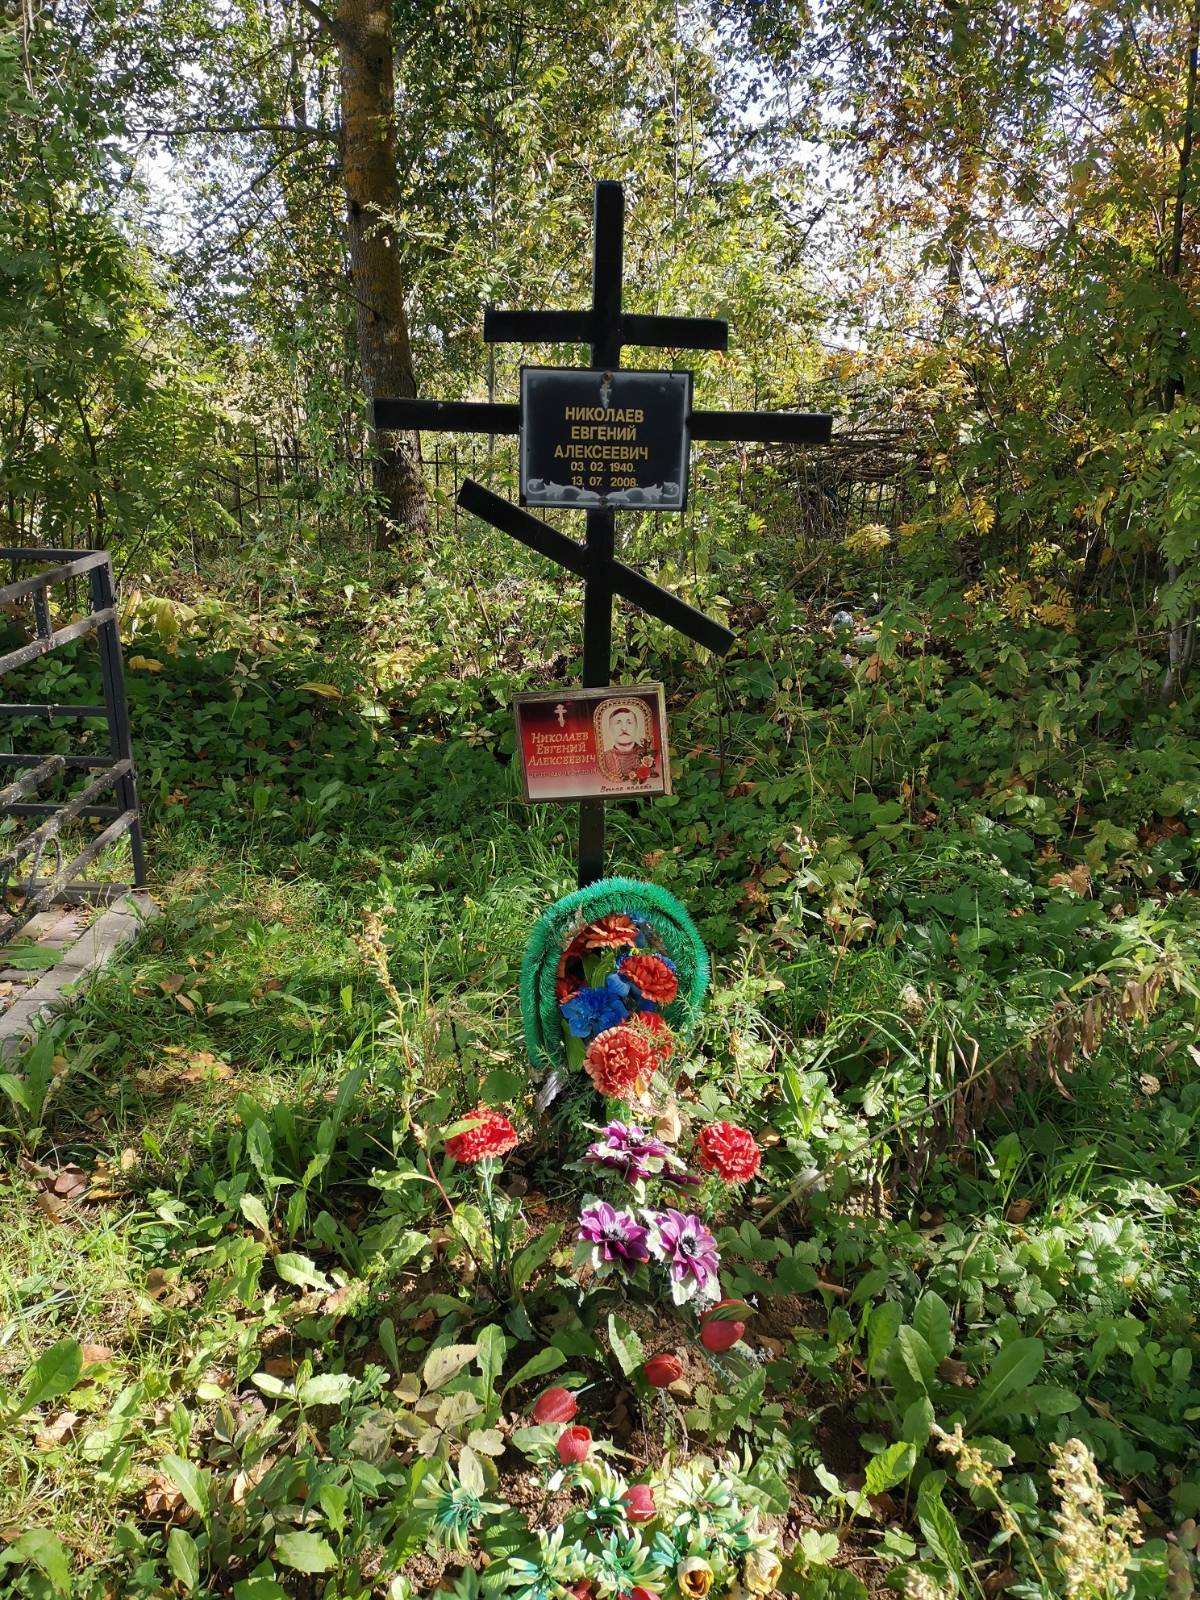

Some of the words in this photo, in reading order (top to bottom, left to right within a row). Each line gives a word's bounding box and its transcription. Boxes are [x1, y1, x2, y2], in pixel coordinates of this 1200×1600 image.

[565, 406, 645, 423] НИКОЛАЕВ
[571, 425, 637, 441] ЕВГЕНИЙ
[554, 445, 649, 460] АЛЕКСЕЕВИЧ
